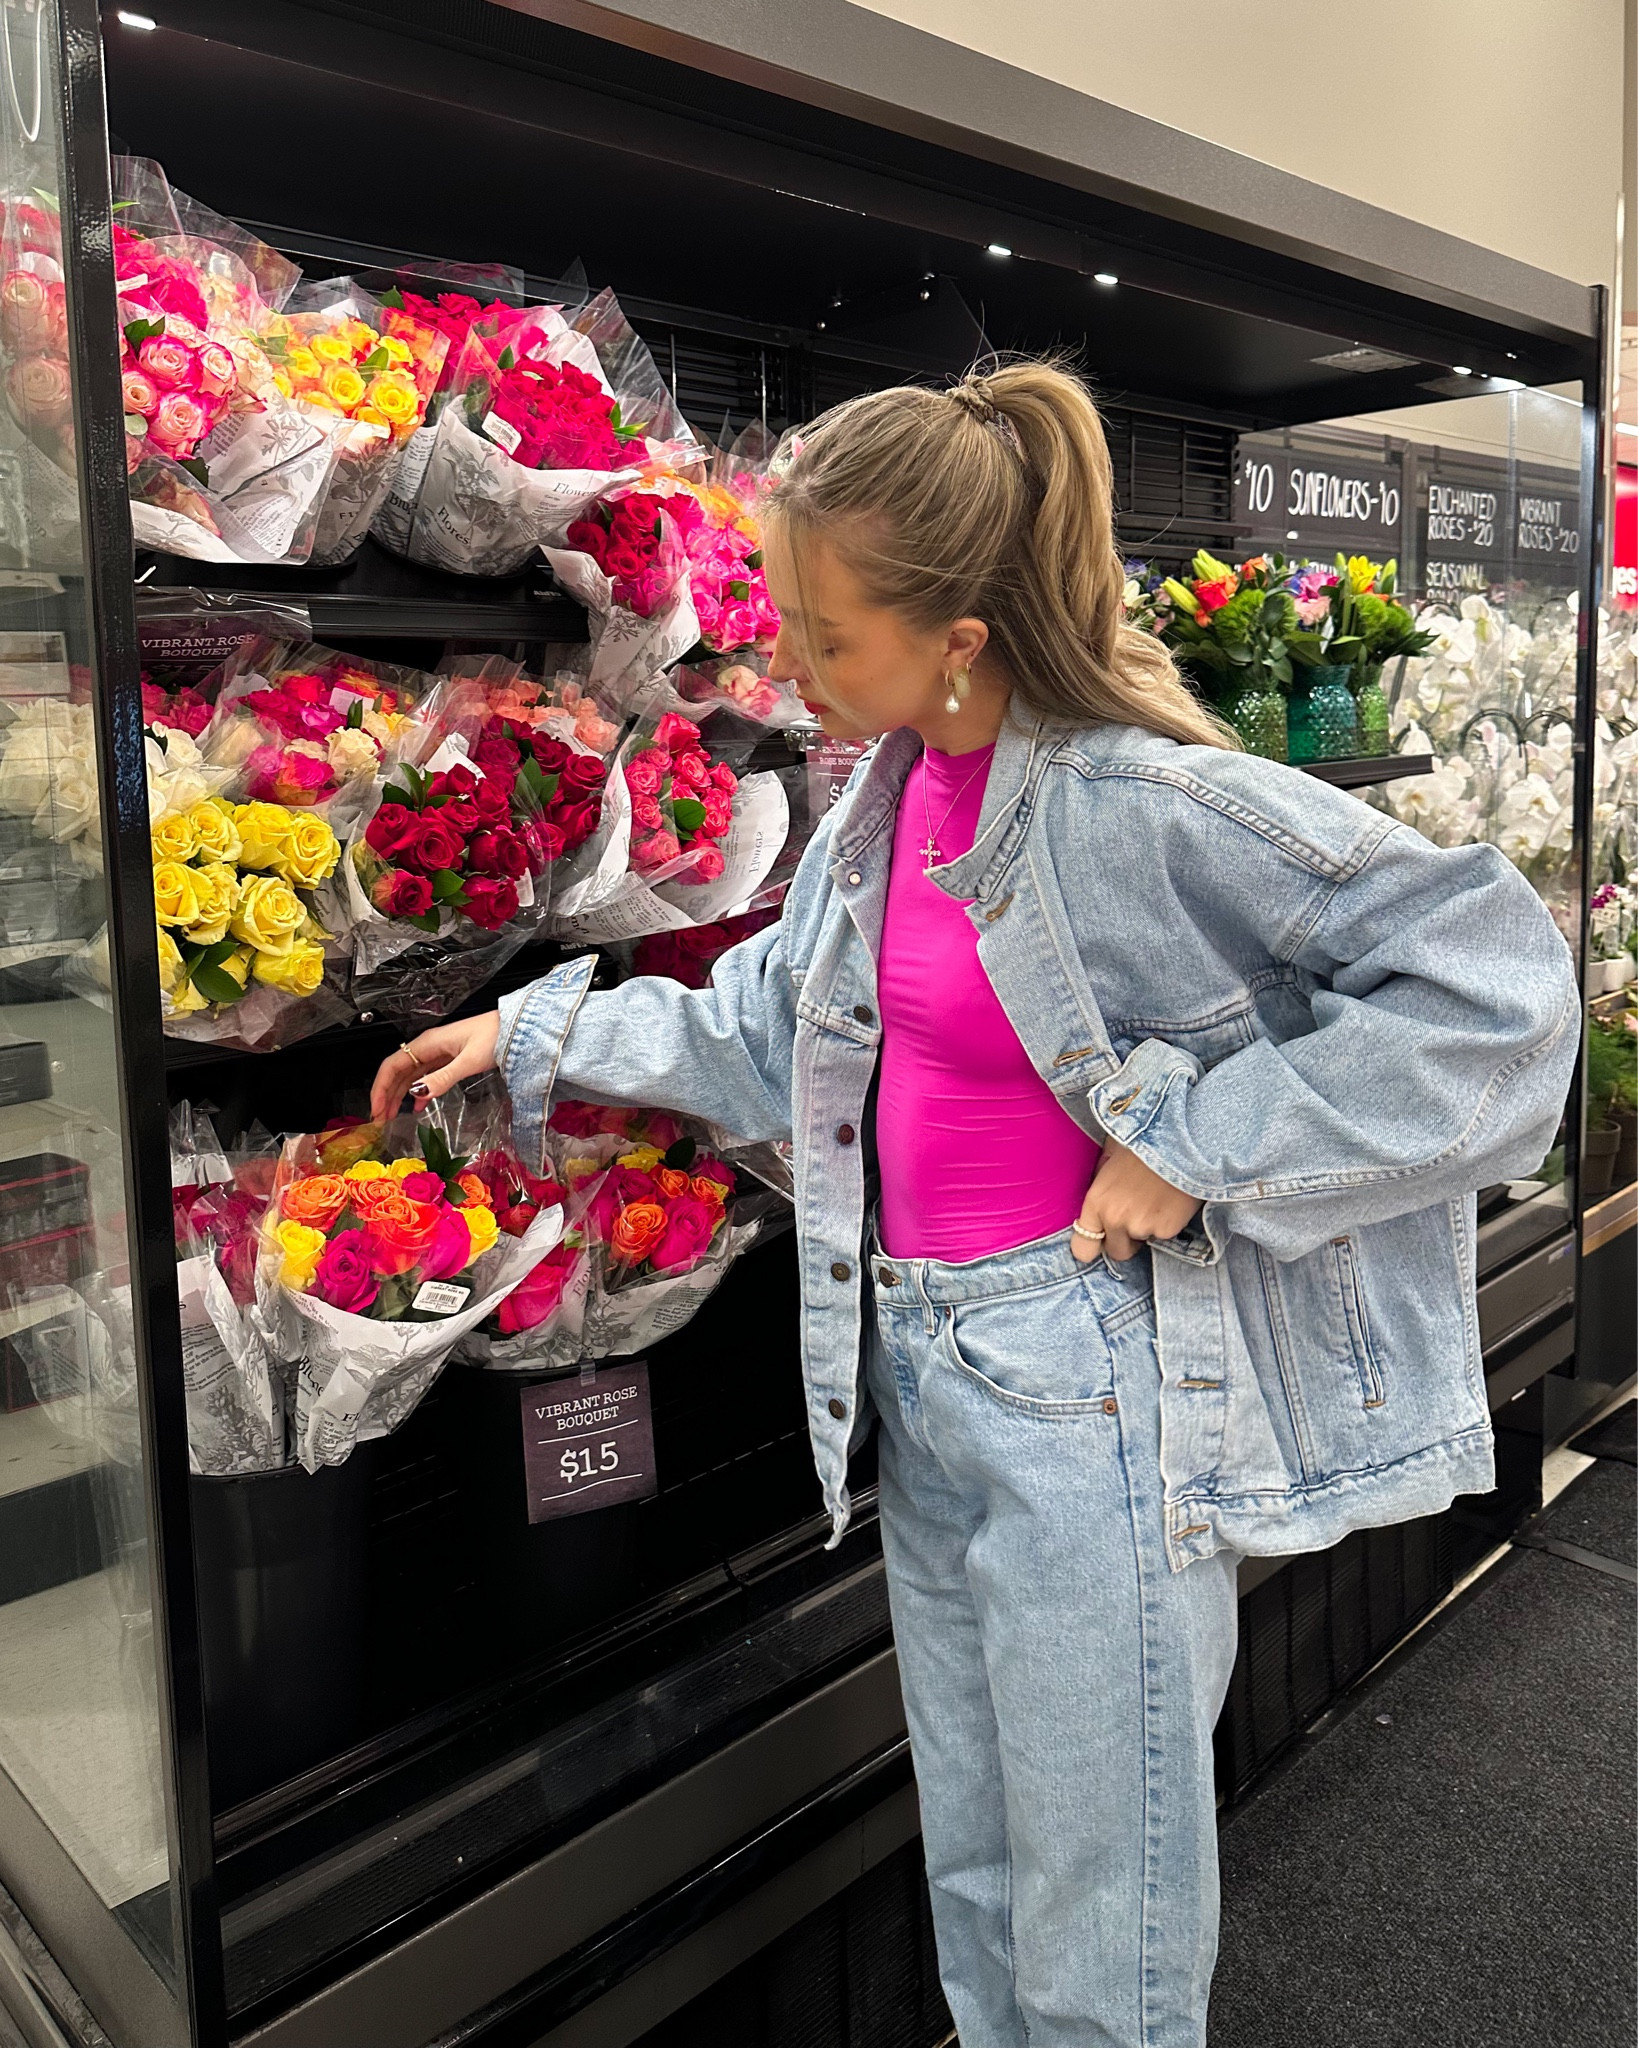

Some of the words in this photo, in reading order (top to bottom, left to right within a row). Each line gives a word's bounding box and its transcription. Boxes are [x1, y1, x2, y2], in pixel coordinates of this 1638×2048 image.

[553, 482, 597, 498] Flower
[1428, 484, 1497, 521] ENCHANTED
[437, 506, 470, 545] Flores
[1518, 497, 1562, 527] VIBRANT
[1425, 561, 1488, 590] SEASONAL
[142, 638, 214, 648] VIBRANT
[216, 634, 256, 646] ROSE
[160, 647, 232, 657] BOUQUET
[838, 757, 857, 766] BOUQ
[535, 1394, 601, 1419] VIBRANT
[603, 1386, 638, 1405] ROSE
[557, 1406, 620, 1431] BOUQUET
[560, 1441, 619, 1484] $15
